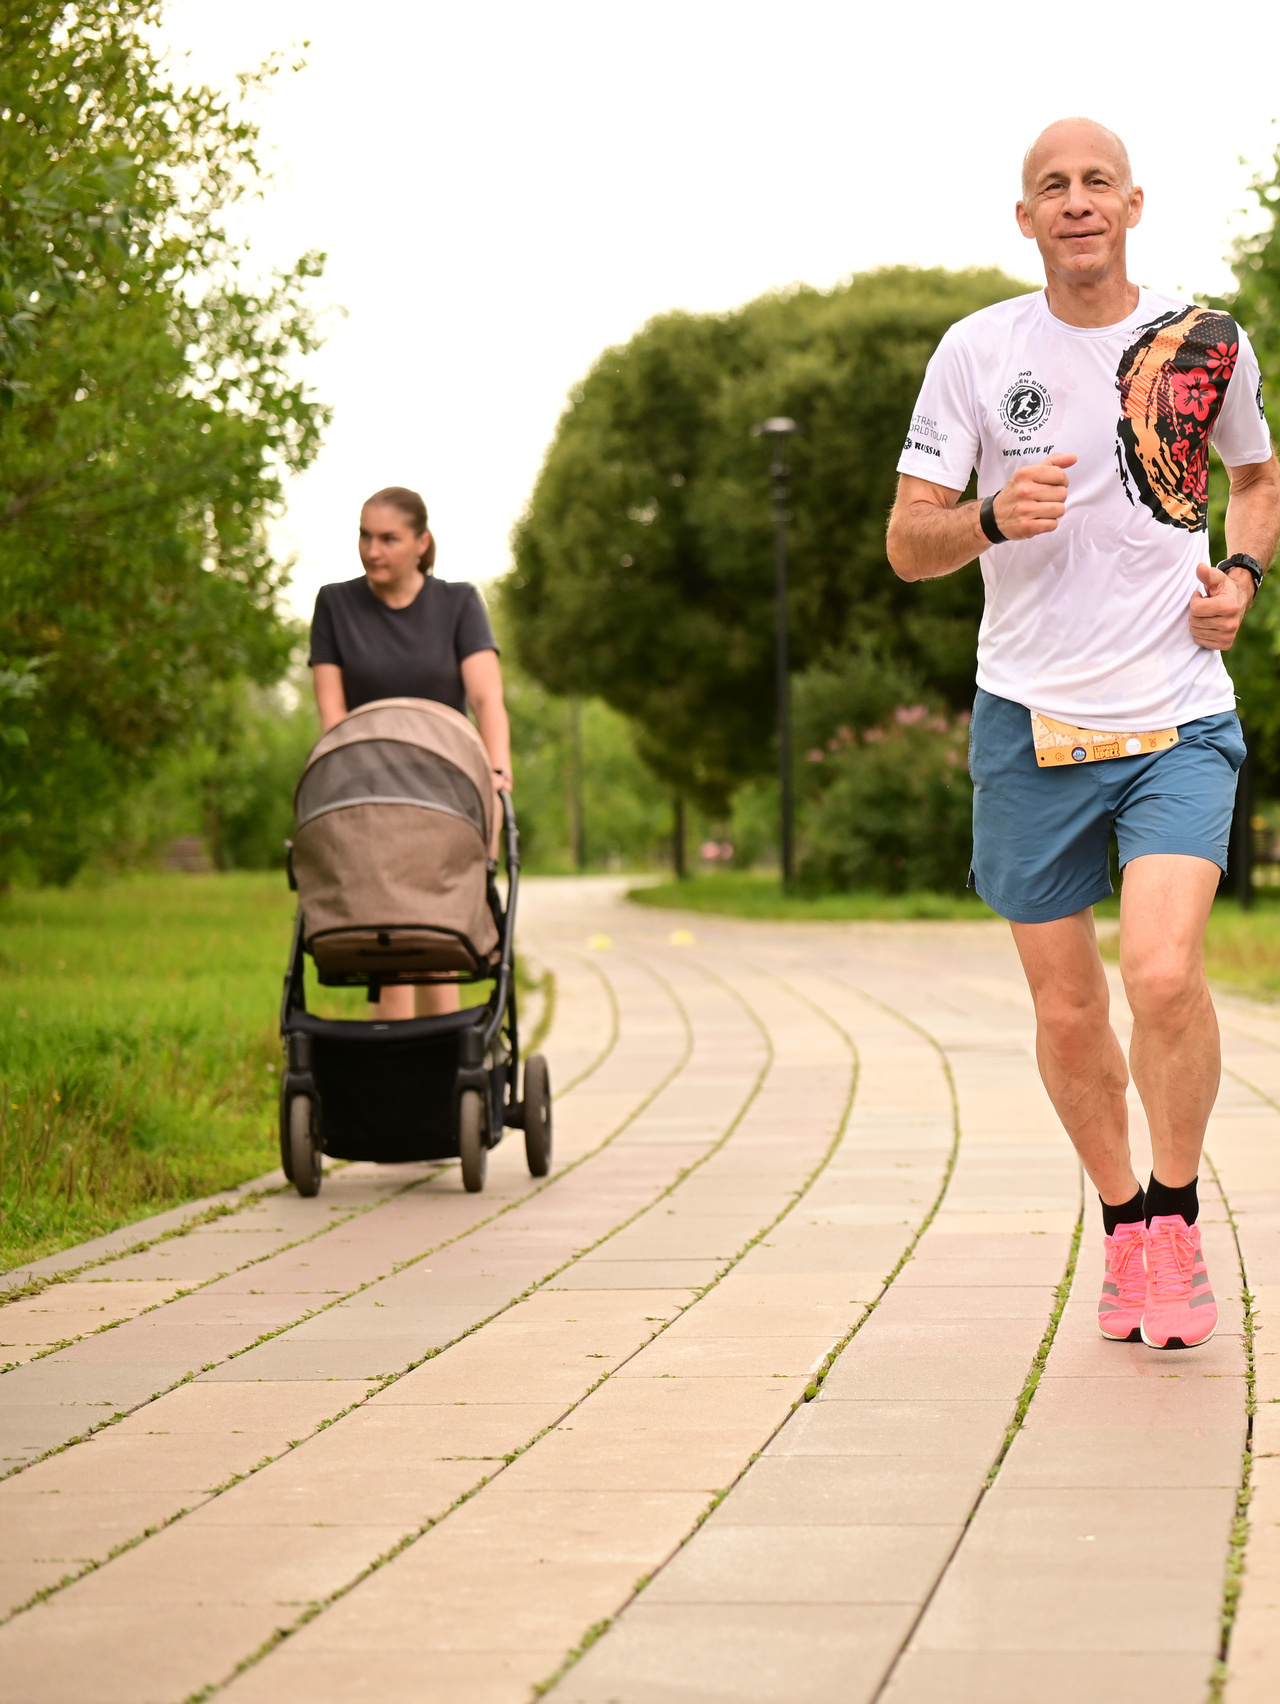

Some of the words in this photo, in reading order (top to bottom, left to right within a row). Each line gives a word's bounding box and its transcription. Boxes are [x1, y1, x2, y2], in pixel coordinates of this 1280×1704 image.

[1004, 379, 1029, 398] GOLDEN
[1031, 380, 1047, 394] RING
[1004, 420, 1024, 434] ULTRA
[1028, 418, 1048, 433] TRAIL
[930, 429, 948, 443] TOUR
[914, 442, 941, 457] RUSSIA
[1002, 449, 1021, 457] NEVER
[1023, 447, 1041, 455] GIVE
[1043, 445, 1054, 455] UP
